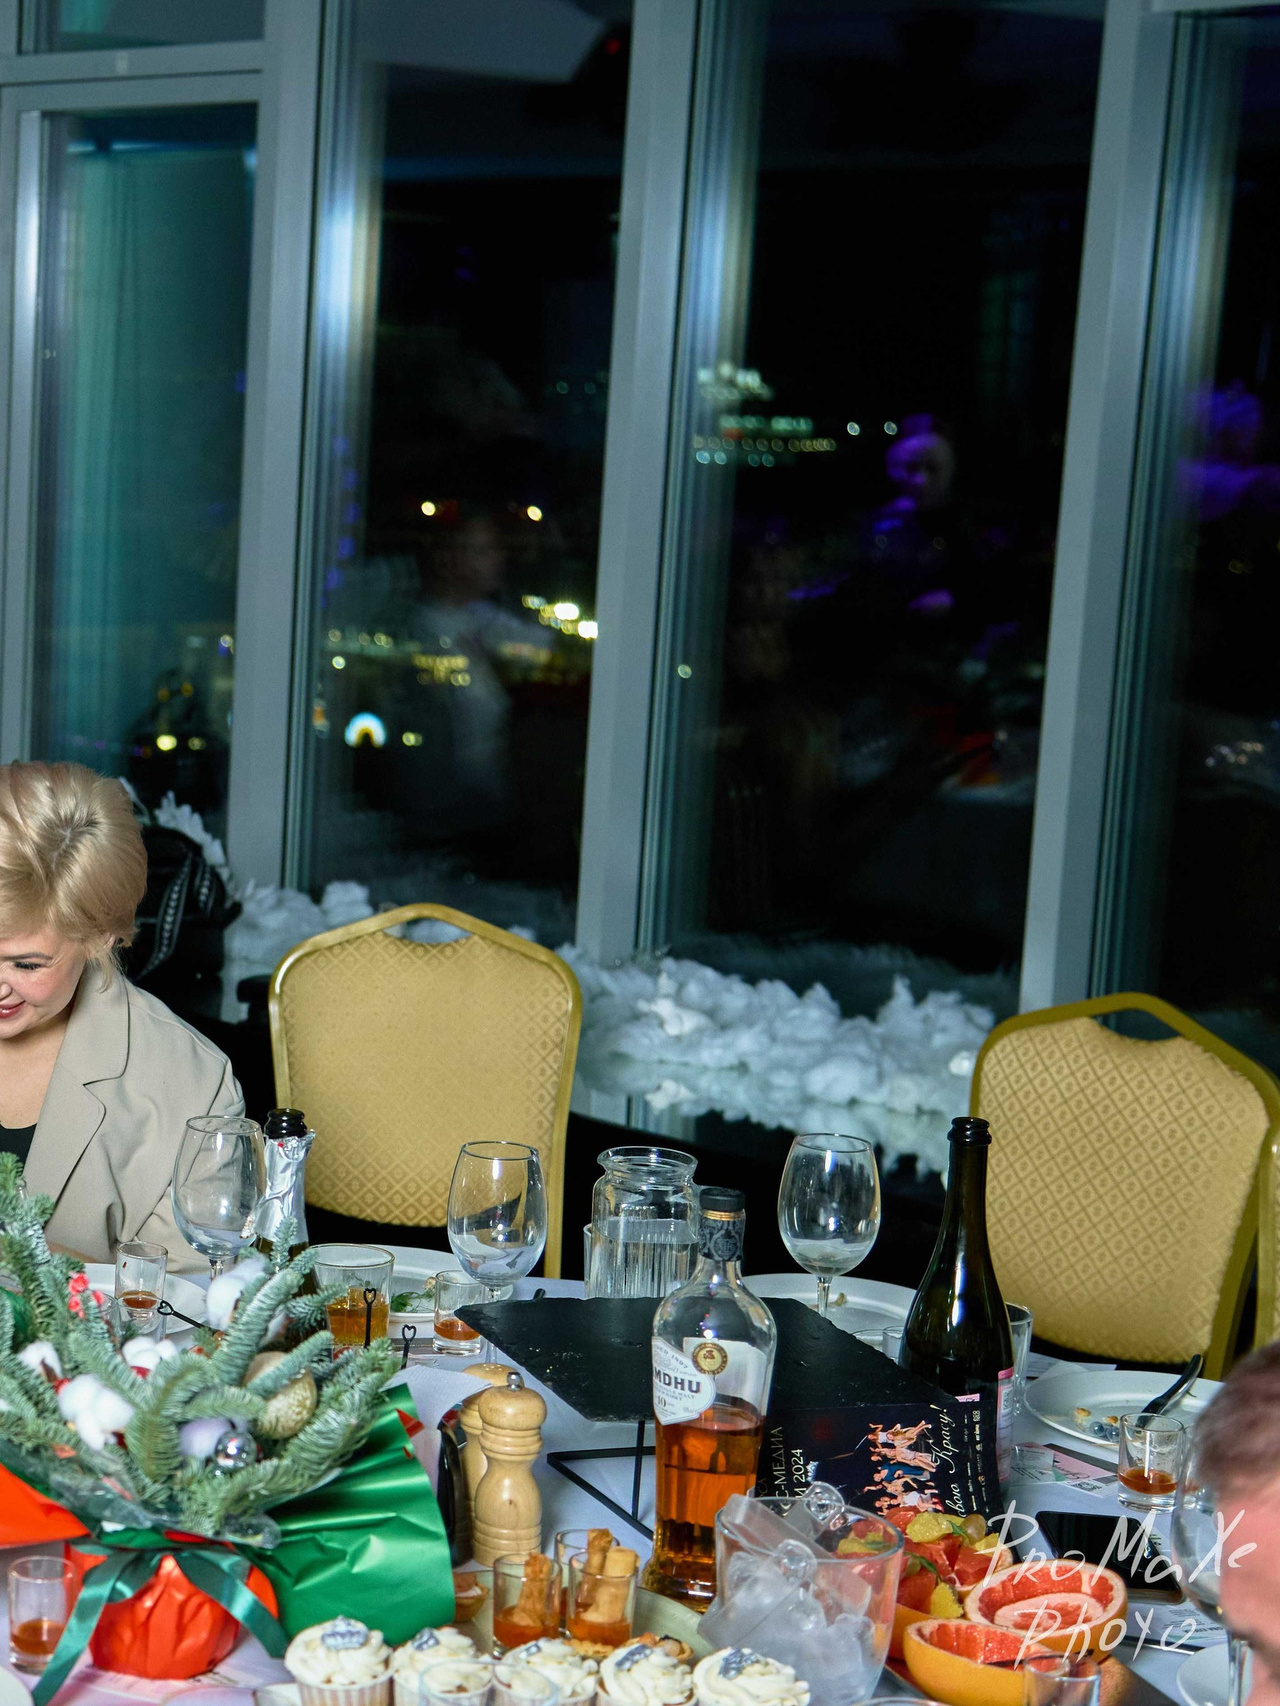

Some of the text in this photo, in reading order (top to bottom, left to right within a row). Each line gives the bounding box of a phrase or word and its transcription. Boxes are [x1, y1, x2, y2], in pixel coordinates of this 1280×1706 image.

[654, 1366, 700, 1394] MDHU
[771, 1427, 790, 1503] С-МЕДИА
[791, 1448, 806, 1484] 2024
